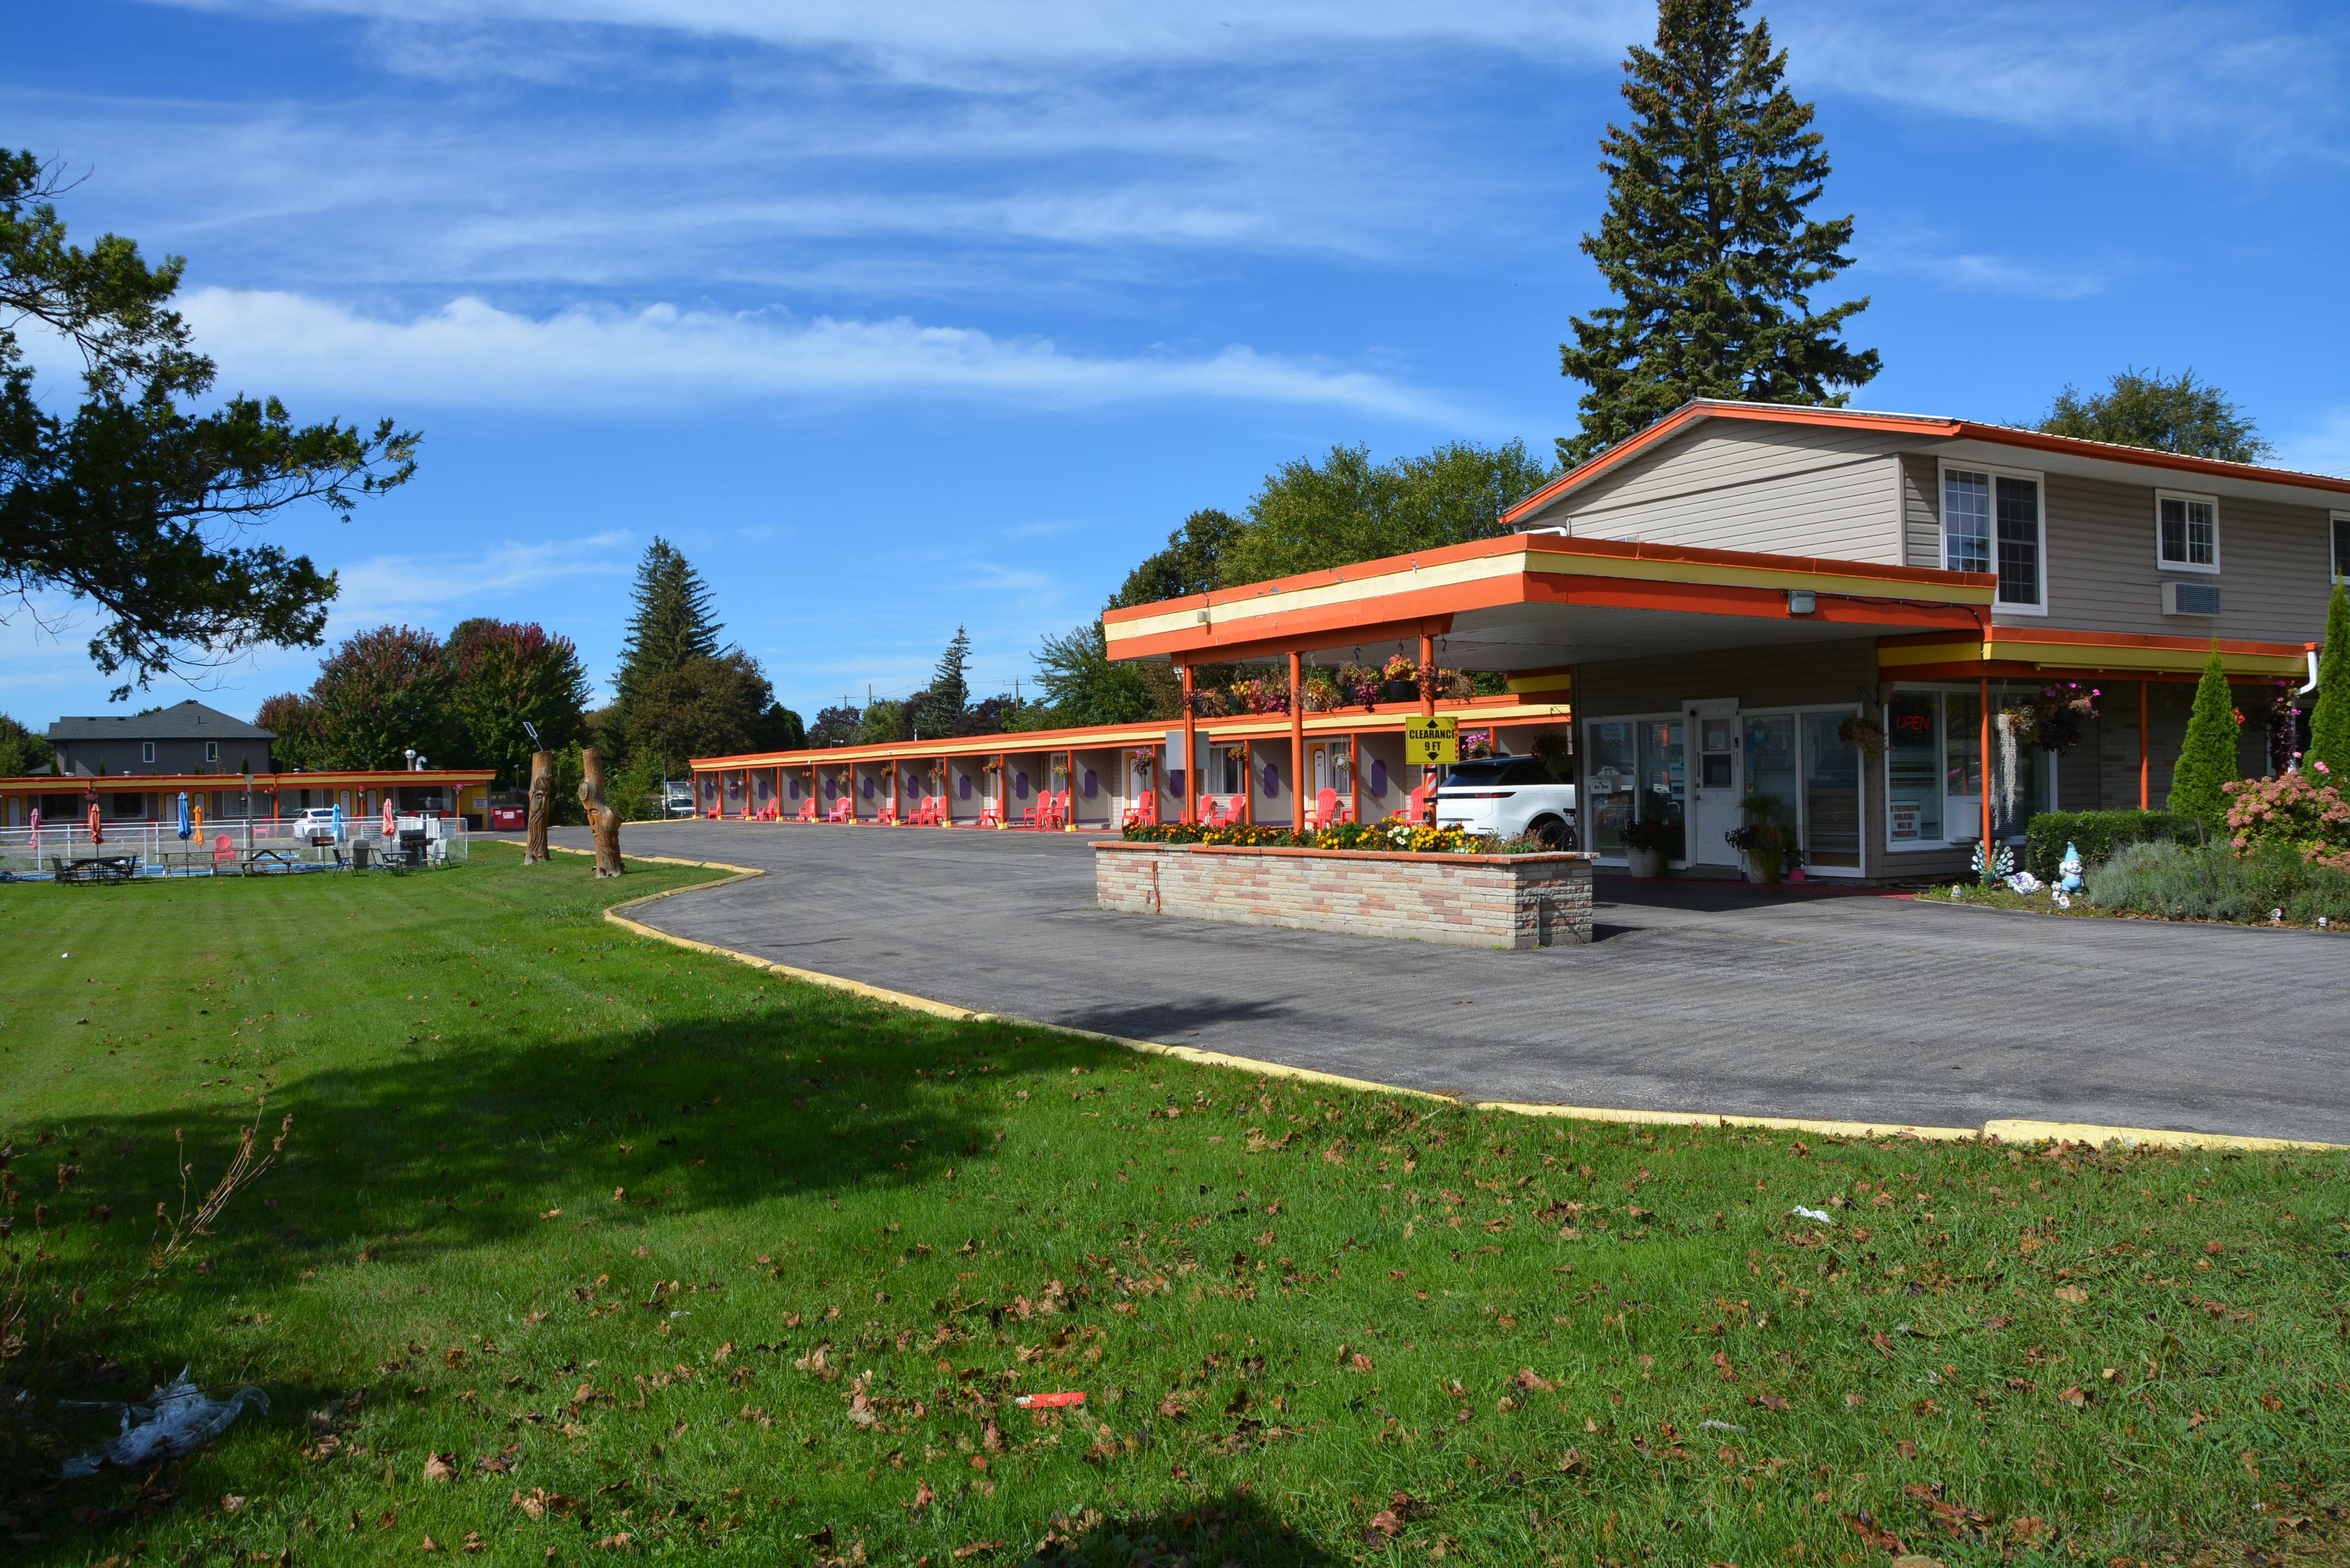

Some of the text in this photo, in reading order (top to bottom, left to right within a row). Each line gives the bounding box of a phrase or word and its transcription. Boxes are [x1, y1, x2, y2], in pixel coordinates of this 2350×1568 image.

[1896, 715, 1931, 730] OPEN
[1409, 730, 1455, 739] CLEARANCE
[1425, 741, 1441, 751] 9 FT
